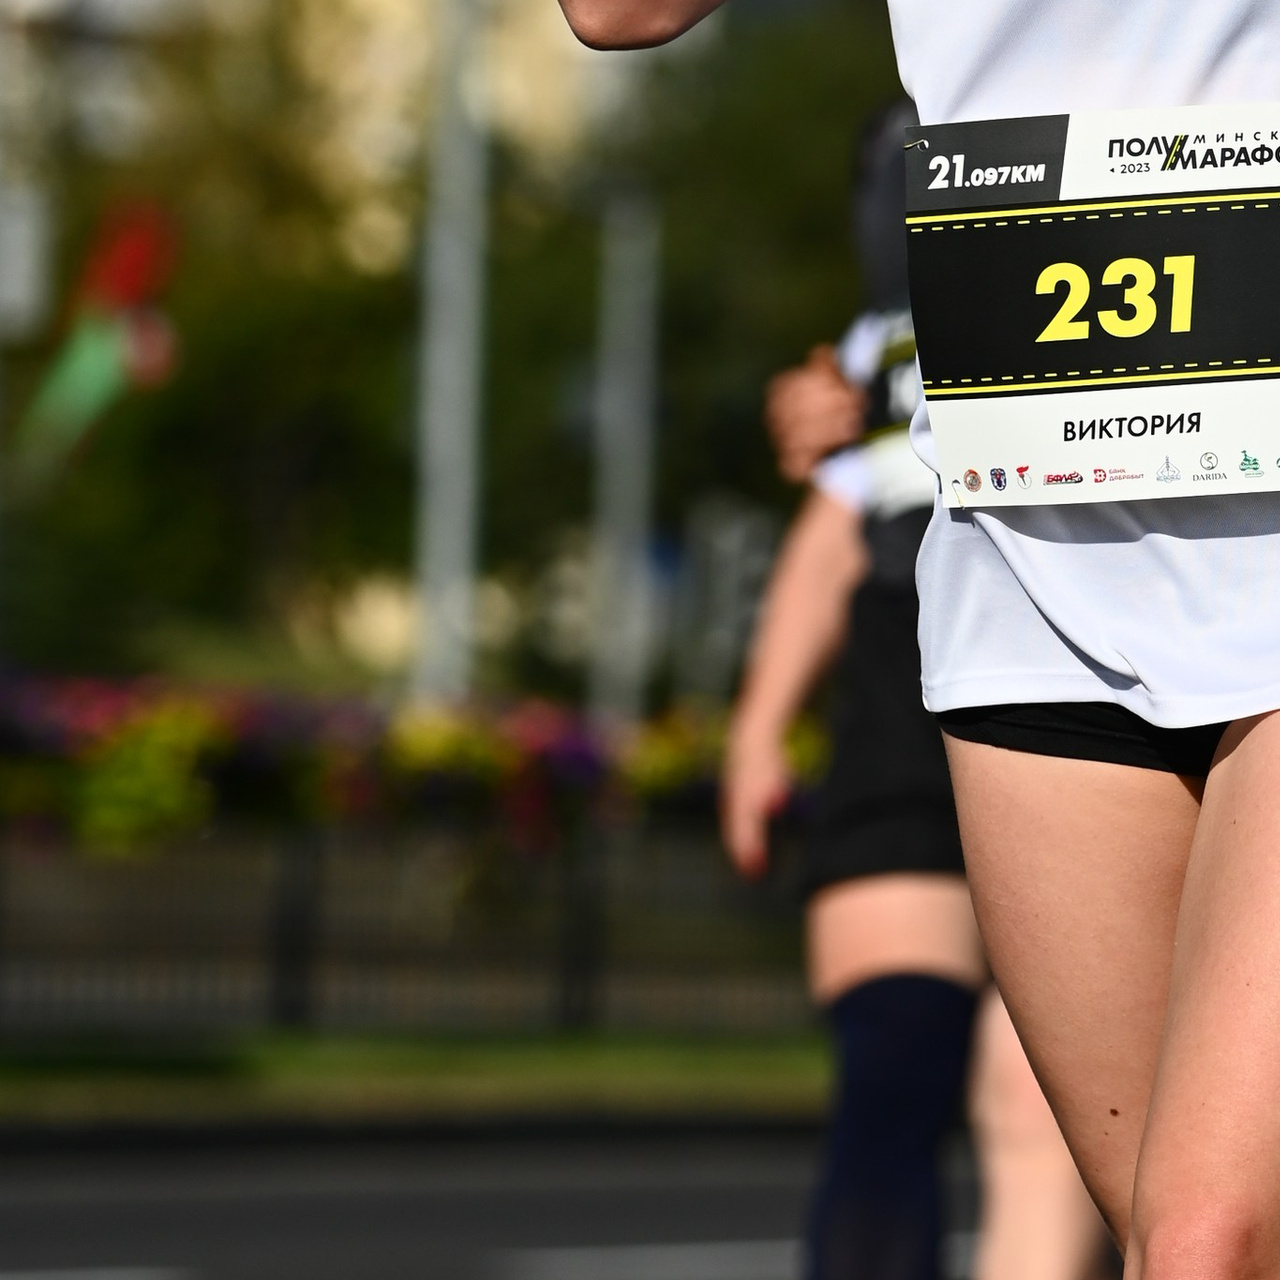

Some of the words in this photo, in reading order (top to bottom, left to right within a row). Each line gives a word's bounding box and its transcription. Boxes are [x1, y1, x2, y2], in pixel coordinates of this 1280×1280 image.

[1108, 134, 1182, 167] ПОЛУ
[1120, 162, 1150, 174] 2023
[1035, 254, 1196, 343] 231
[1063, 412, 1202, 442] ВИКТОРИЯ
[1192, 472, 1228, 482] DARIDA
